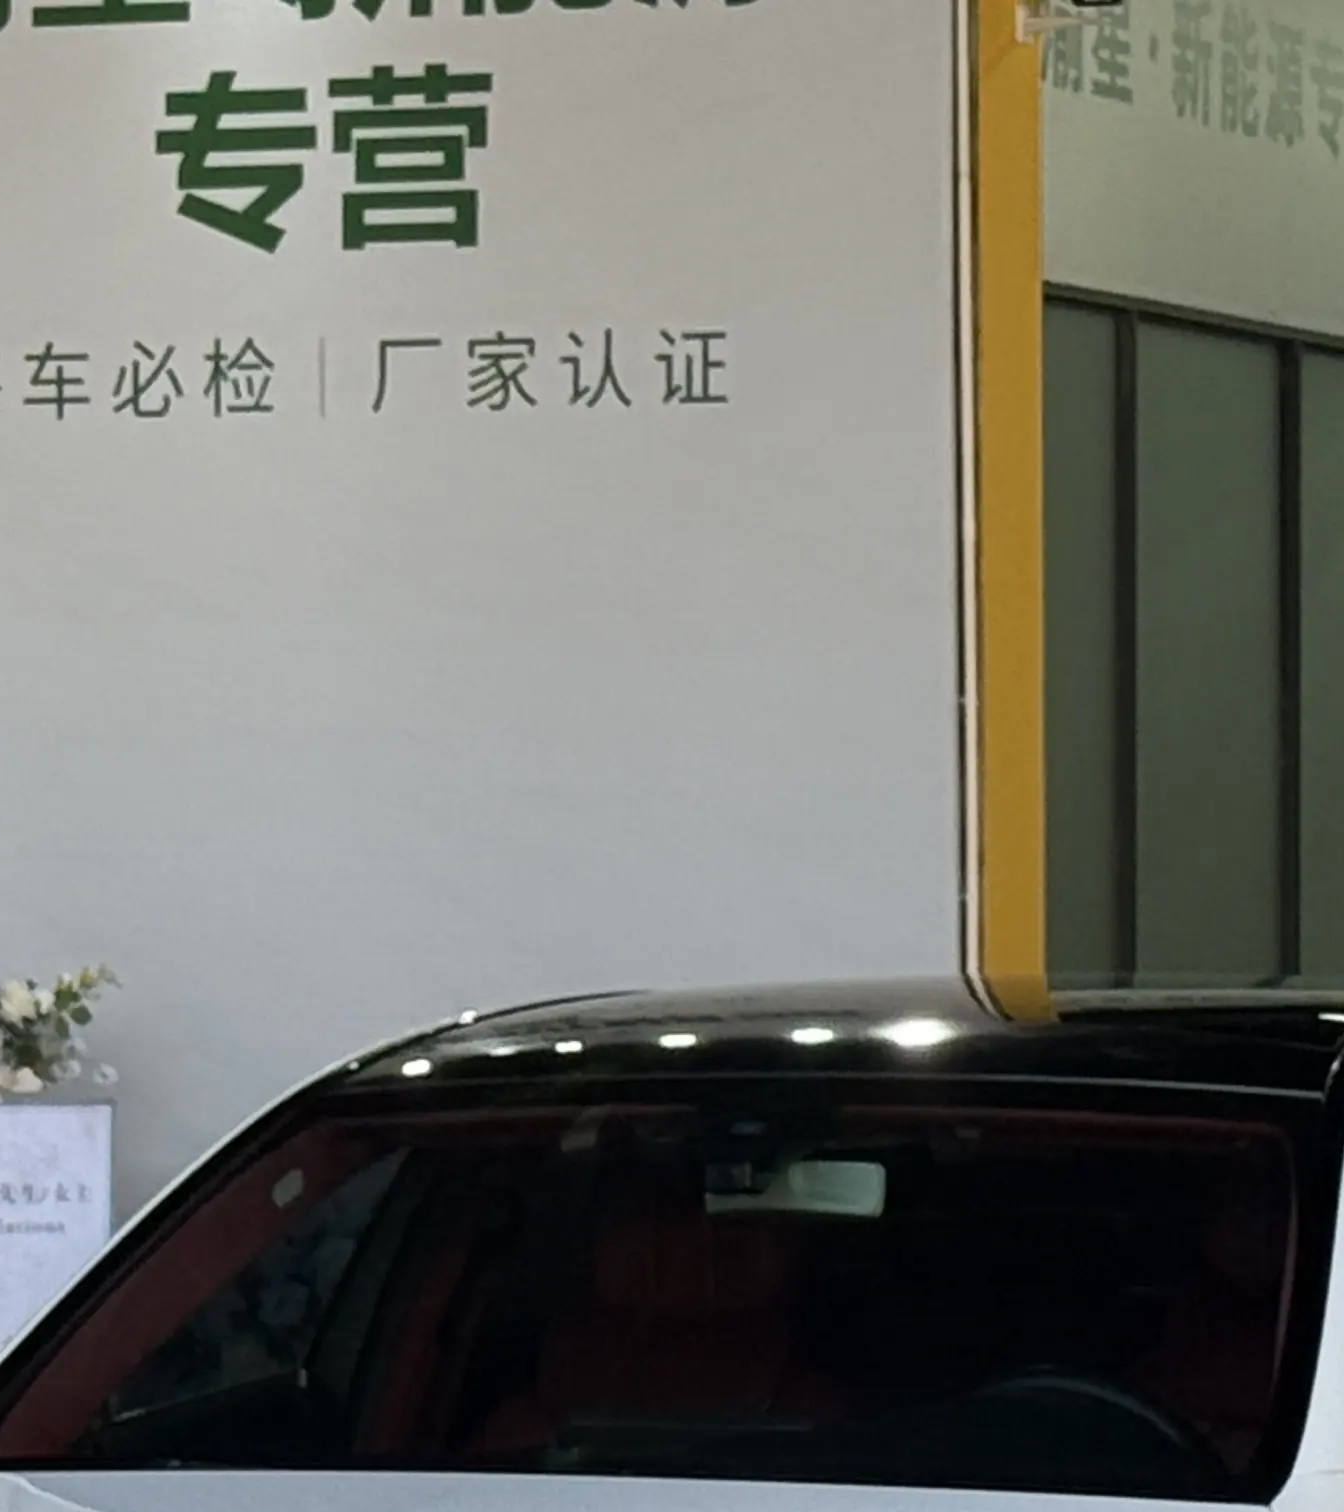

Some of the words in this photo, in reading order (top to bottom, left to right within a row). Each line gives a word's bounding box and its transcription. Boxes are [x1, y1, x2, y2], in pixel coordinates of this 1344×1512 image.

[155, 63, 494, 254] 专营
[371, 327, 730, 413] 厂家认证
